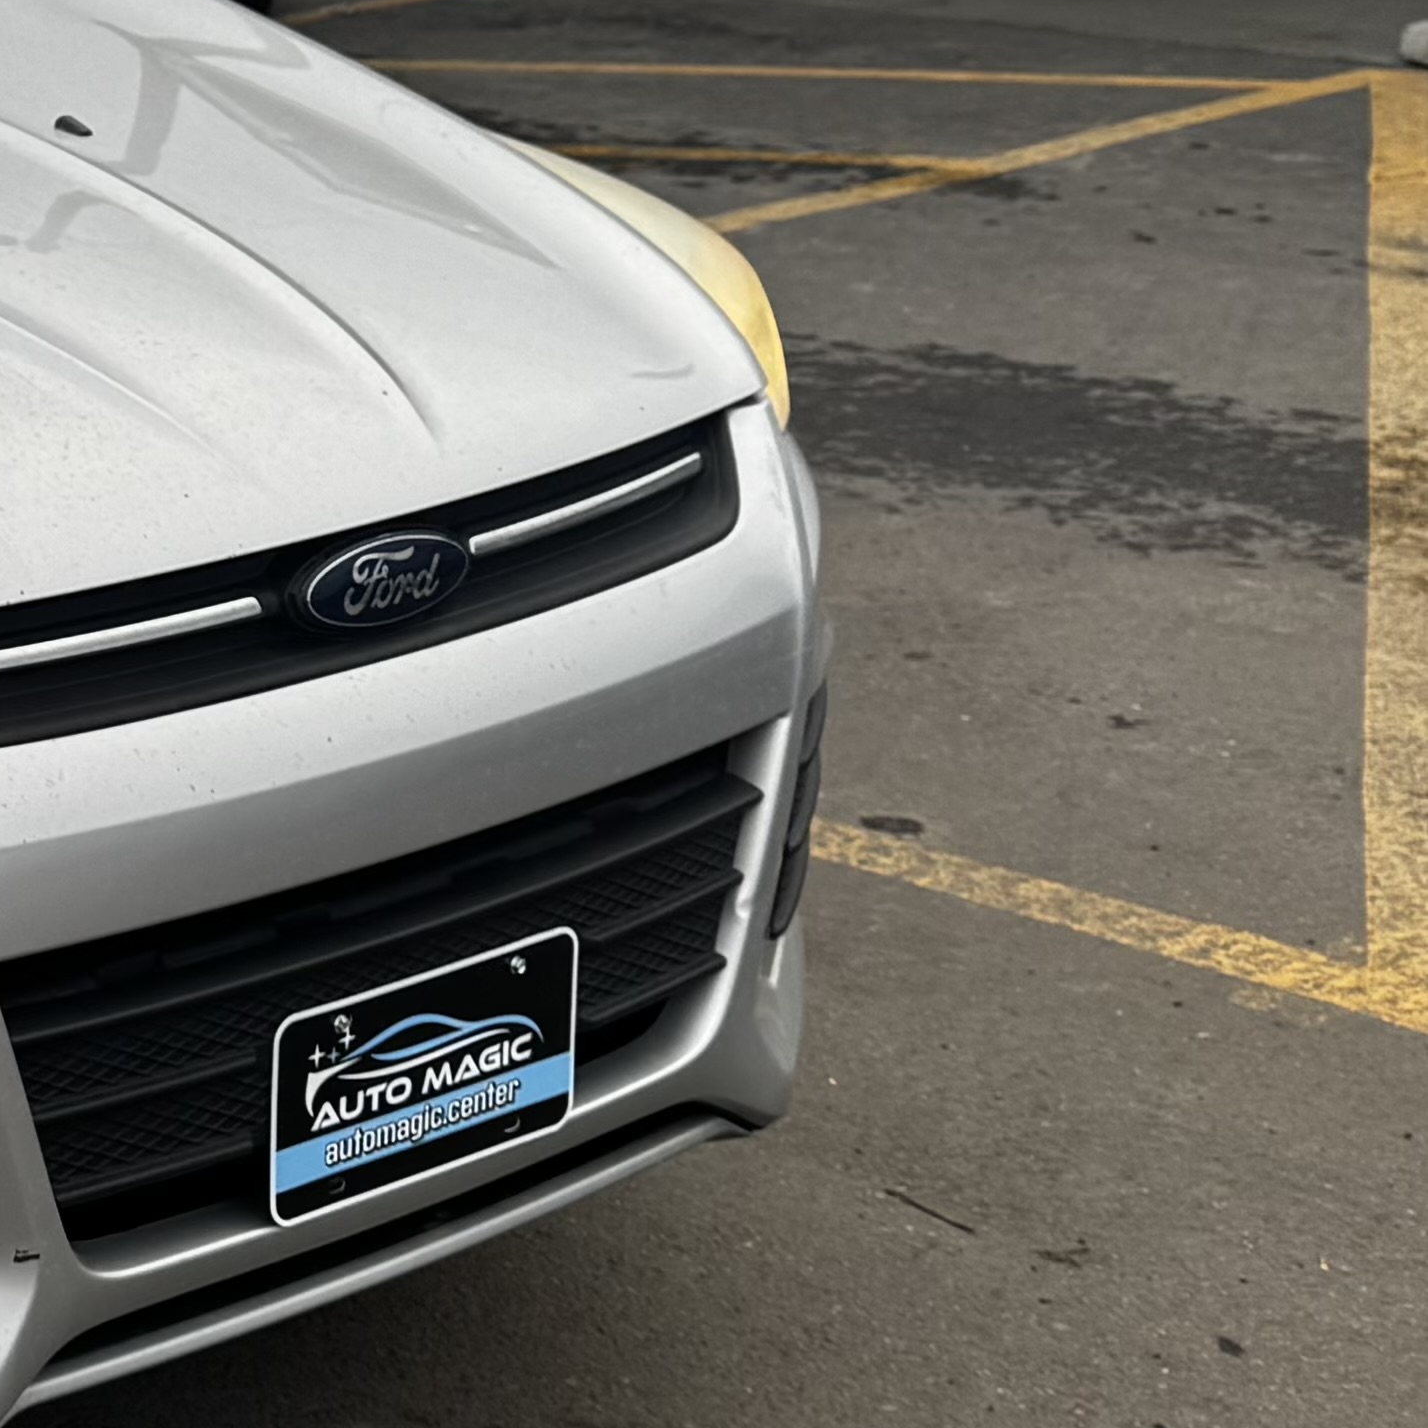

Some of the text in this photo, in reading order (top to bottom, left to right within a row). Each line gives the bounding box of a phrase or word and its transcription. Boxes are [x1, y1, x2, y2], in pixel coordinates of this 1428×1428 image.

[344, 546, 440, 616] Ford
[310, 1032, 534, 1133] AUTO MAGIC
[324, 1077, 520, 1168] automagic.center
